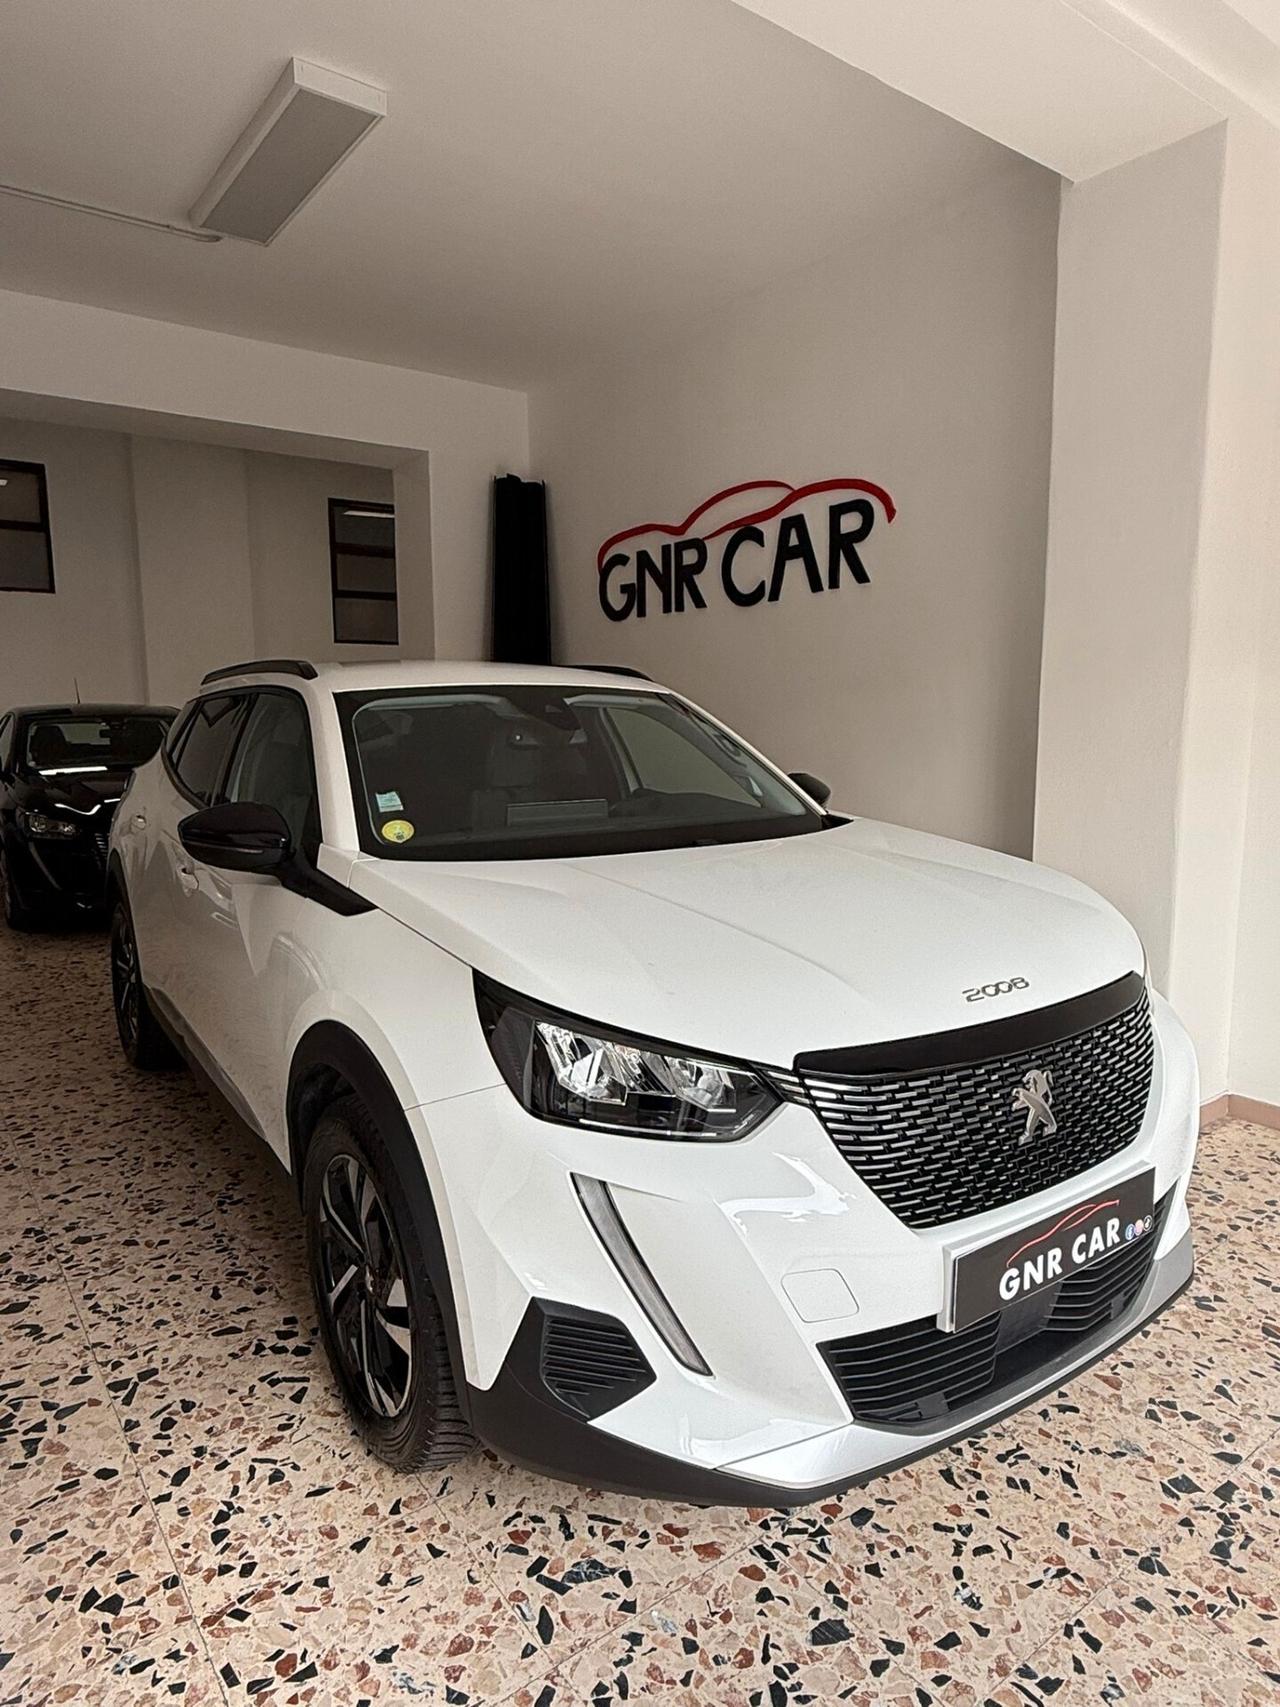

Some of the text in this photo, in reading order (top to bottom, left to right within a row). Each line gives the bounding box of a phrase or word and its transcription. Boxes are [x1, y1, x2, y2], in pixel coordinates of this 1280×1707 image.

[599, 499, 875, 622] GNR CAR
[962, 977, 1030, 1002] 2008
[999, 1218, 1120, 1300] GNR CAR
